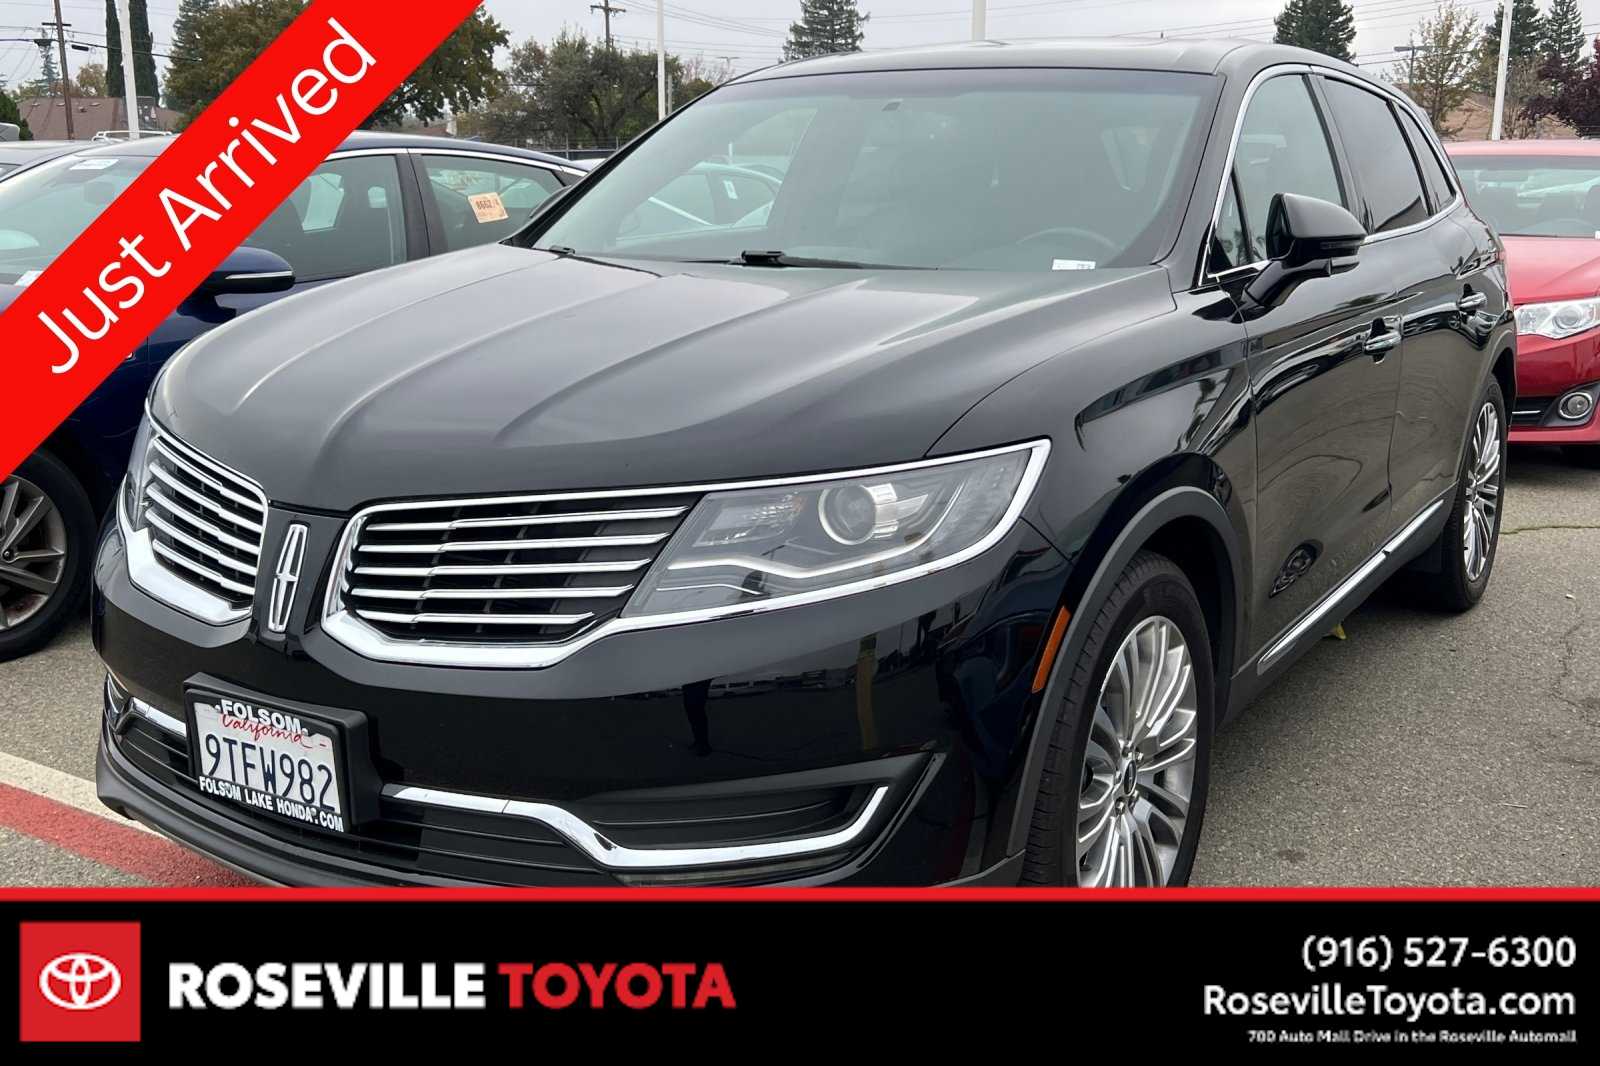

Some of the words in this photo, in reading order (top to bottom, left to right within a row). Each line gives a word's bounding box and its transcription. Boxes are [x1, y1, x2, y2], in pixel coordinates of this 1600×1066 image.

[220, 699, 302, 734] FOLSOM
[221, 713, 312, 749] California
[205, 733, 336, 812] 9TFW982
[199, 775, 242, 802] FOLSOM
[244, 788, 275, 811] LAKE
